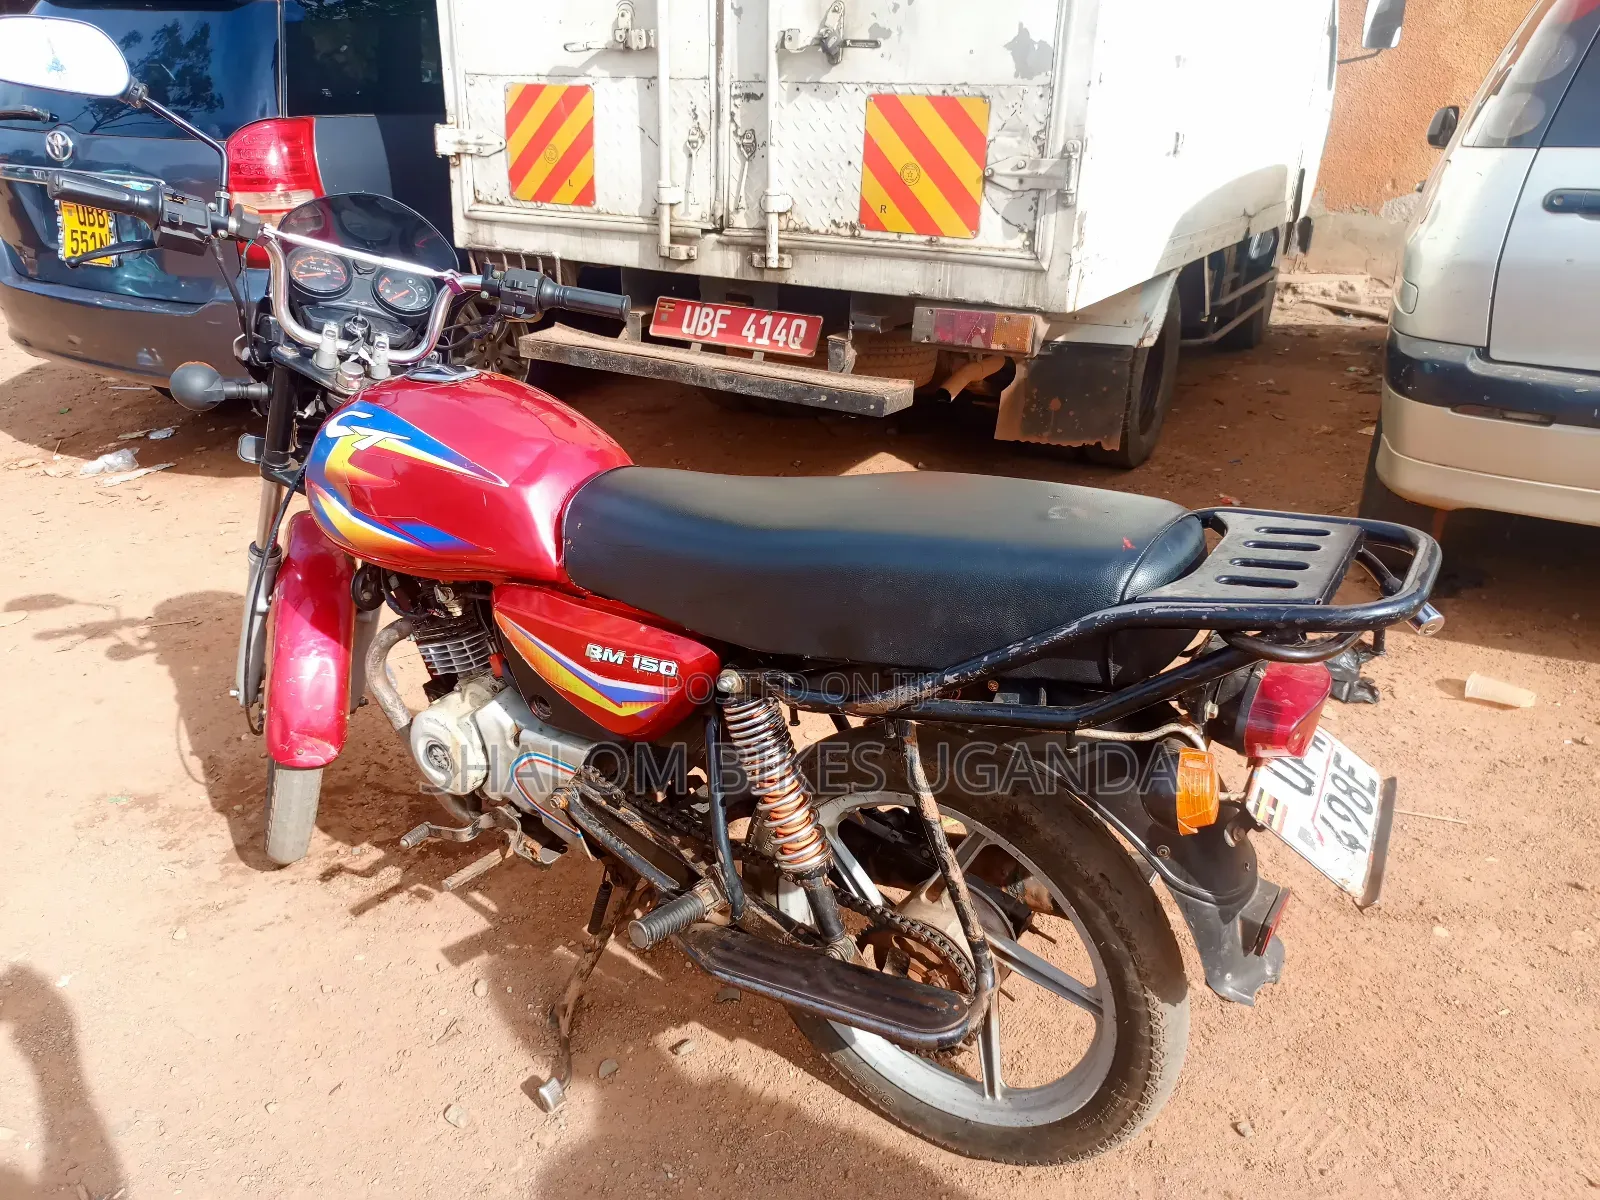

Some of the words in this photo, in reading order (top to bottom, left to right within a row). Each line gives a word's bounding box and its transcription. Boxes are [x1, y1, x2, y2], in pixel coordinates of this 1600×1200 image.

[880, 204, 887, 214] R
[681, 305, 731, 338] UBF
[741, 313, 808, 350] 414Q
[585, 643, 626, 665] BM
[632, 653, 678, 677] 150
